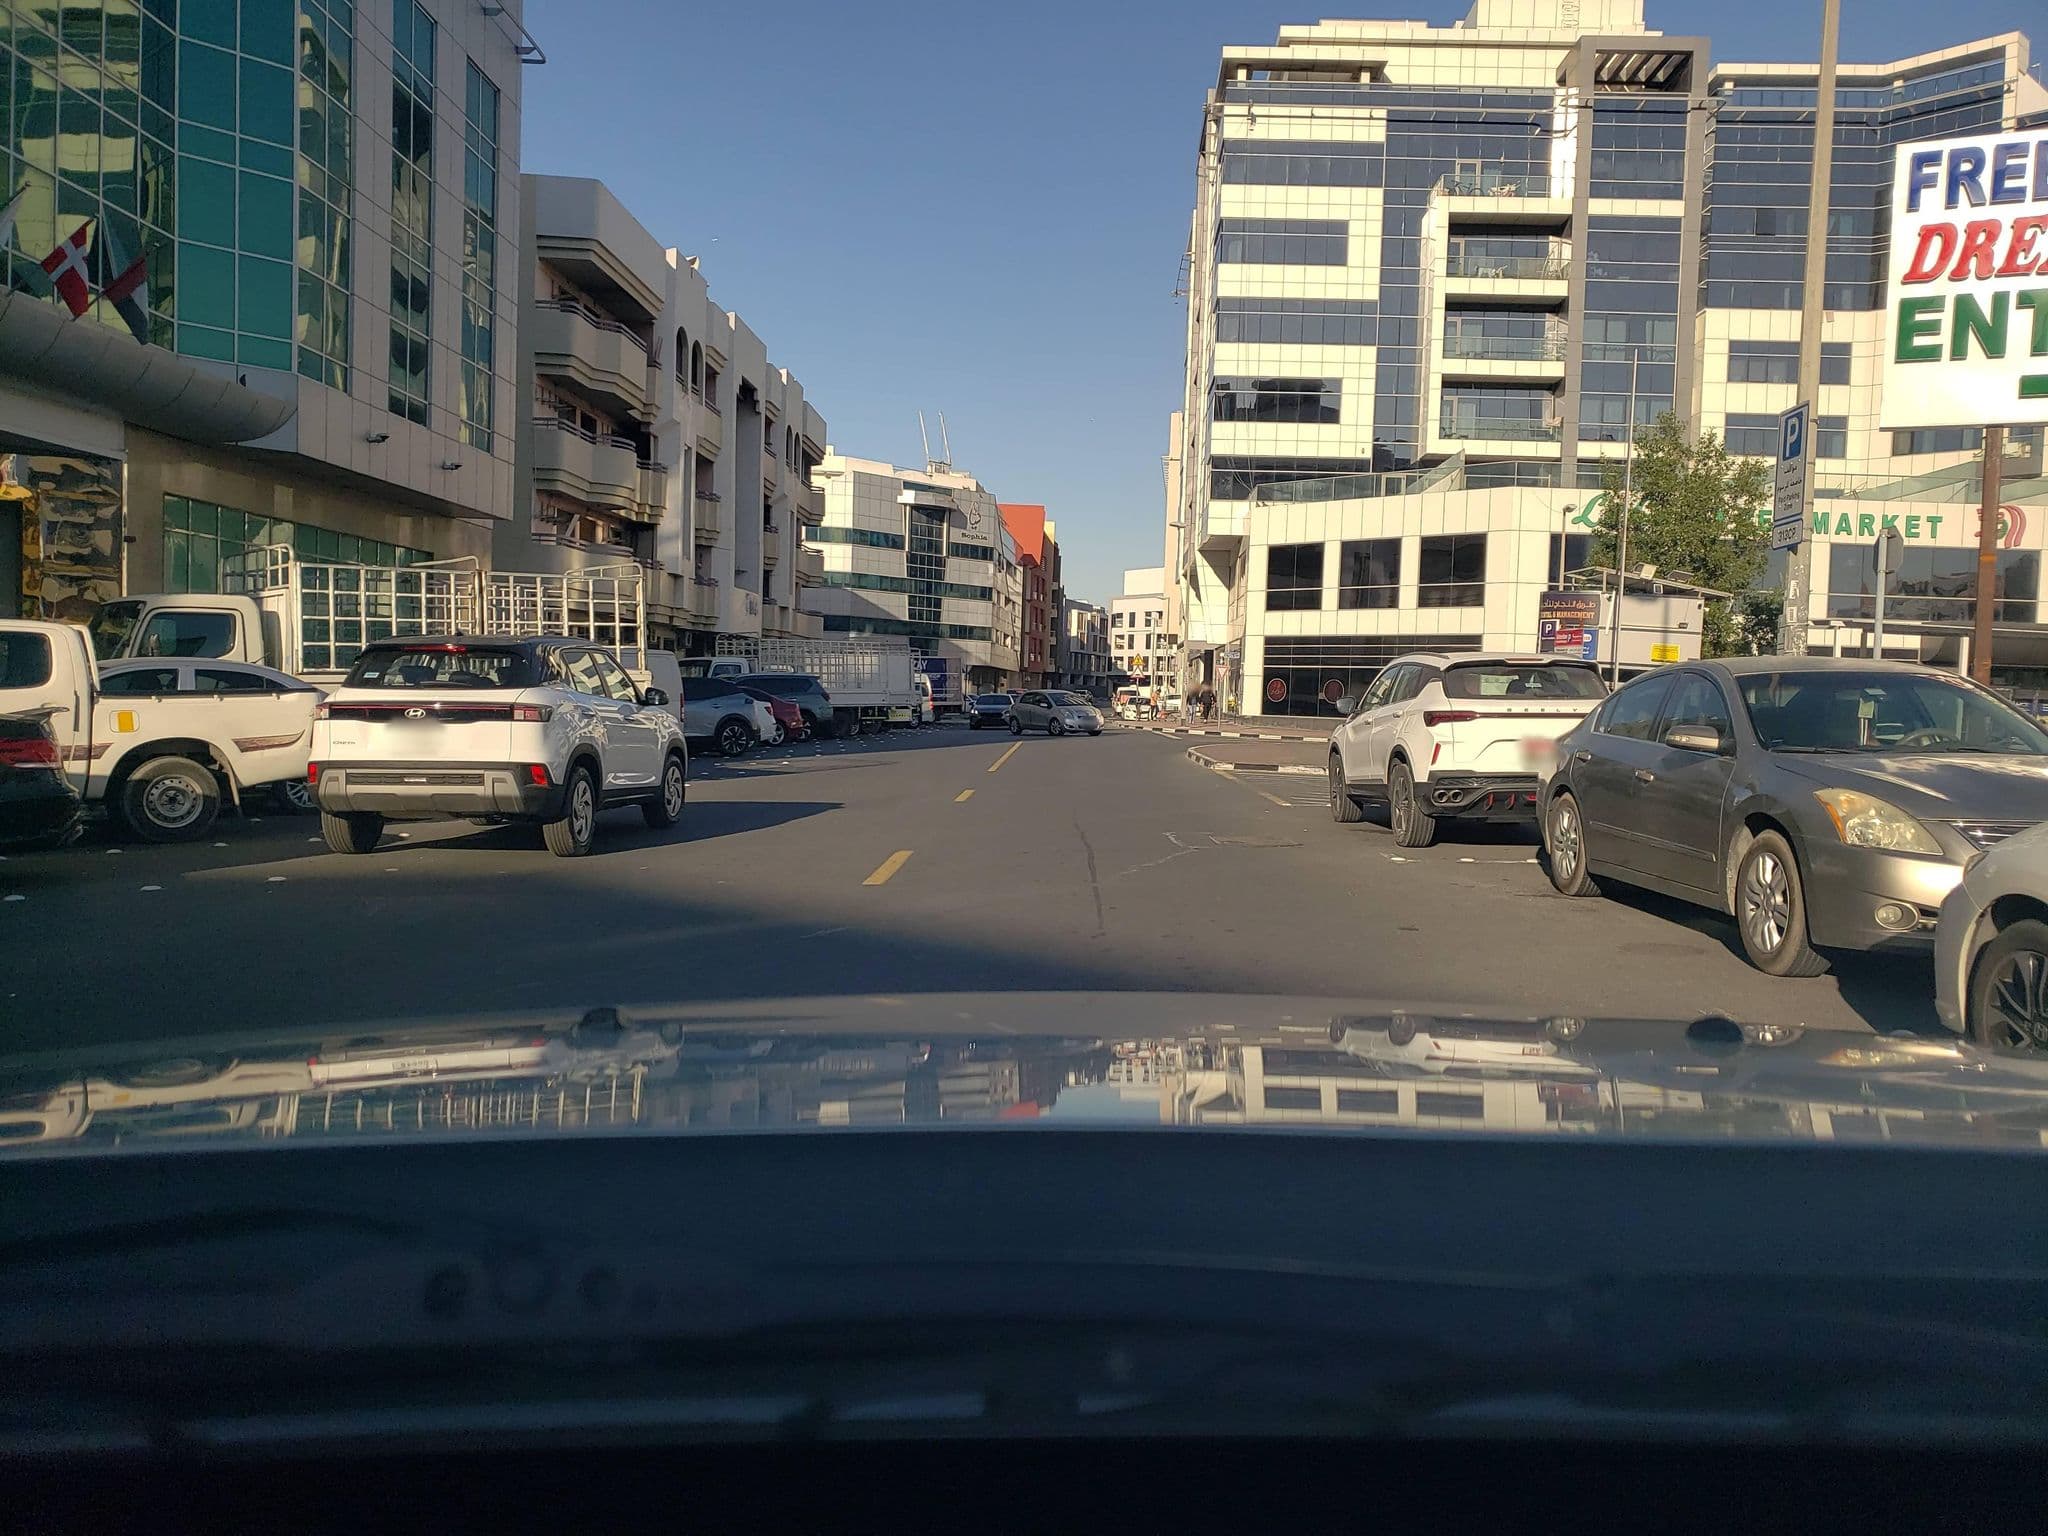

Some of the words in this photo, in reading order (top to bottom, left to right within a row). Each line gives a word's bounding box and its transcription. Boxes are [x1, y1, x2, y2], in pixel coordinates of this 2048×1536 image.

[1900, 214, 2048, 286] DRE
[1785, 416, 1800, 457] P
[961, 532, 988, 541] Sophia
[1545, 623, 1552, 634] P
